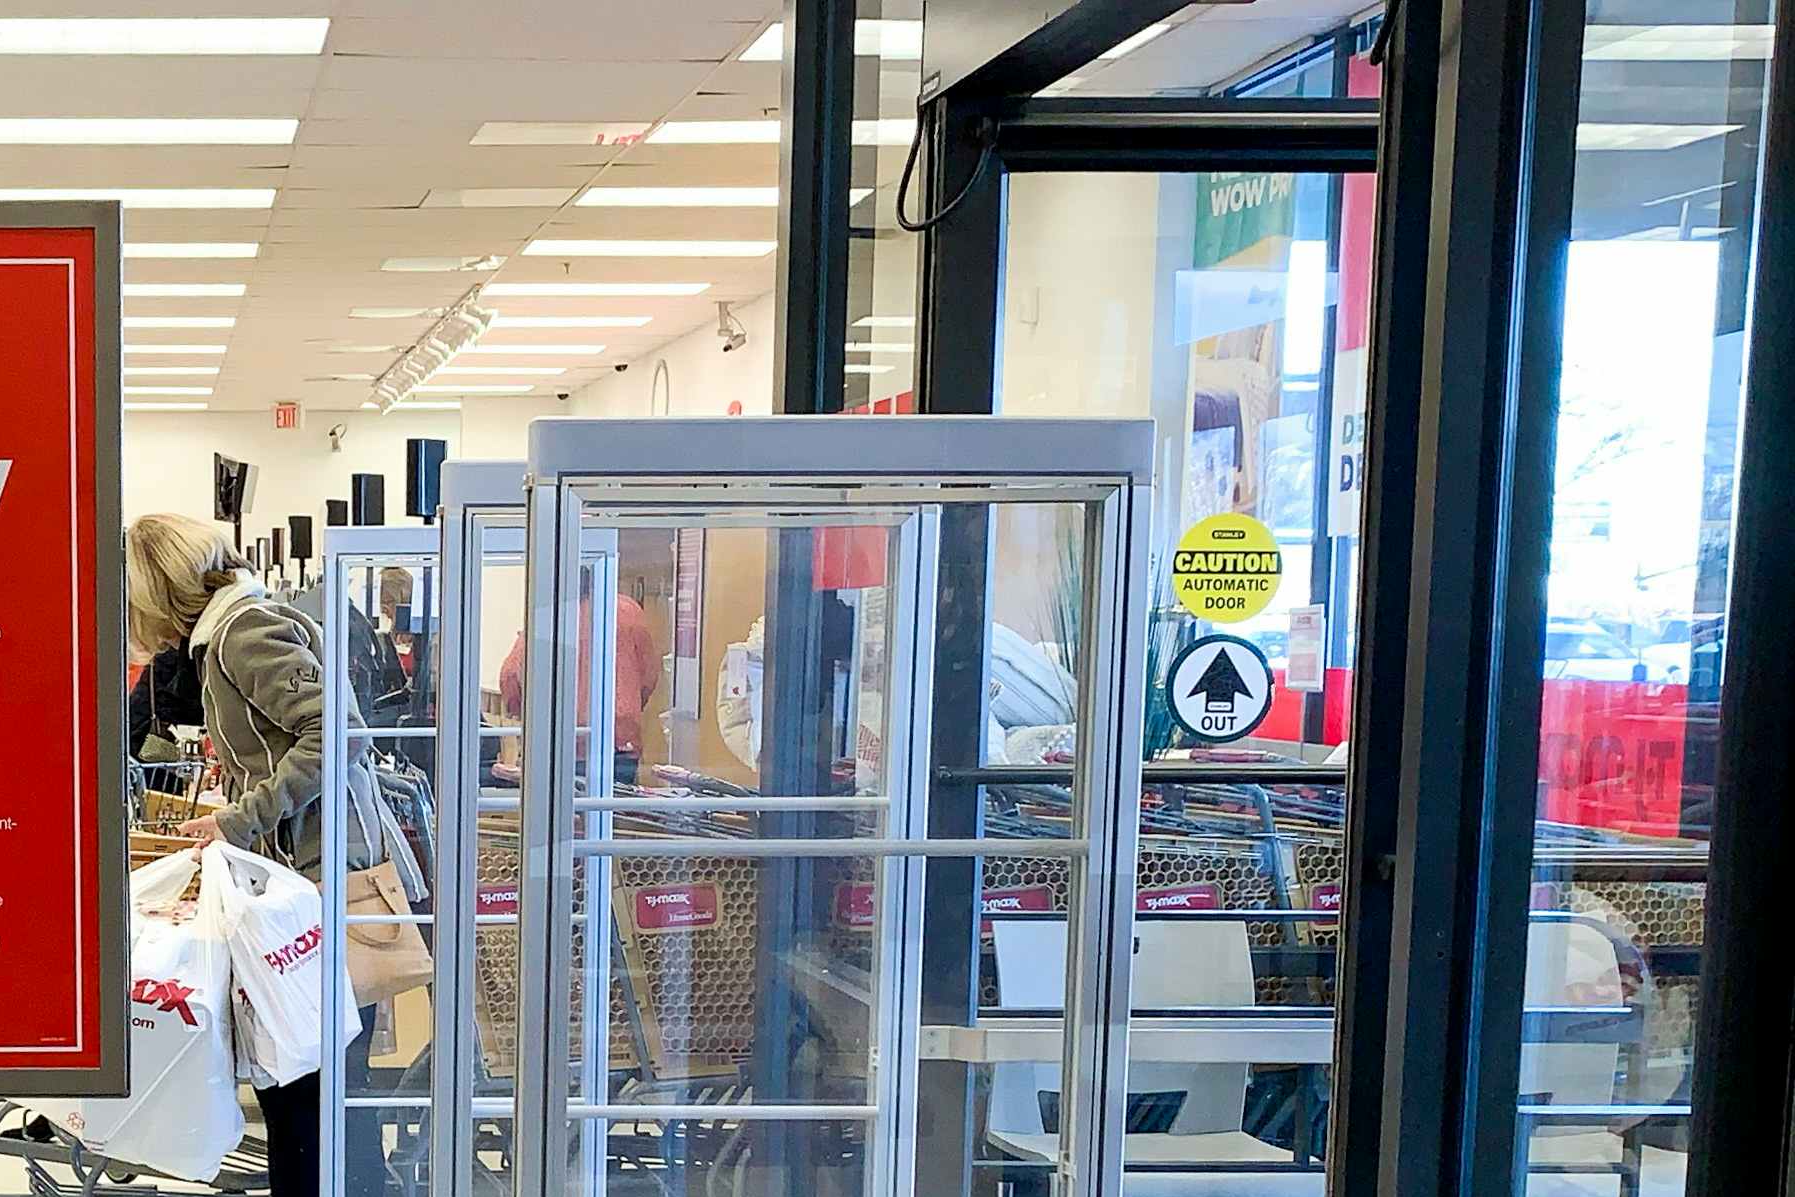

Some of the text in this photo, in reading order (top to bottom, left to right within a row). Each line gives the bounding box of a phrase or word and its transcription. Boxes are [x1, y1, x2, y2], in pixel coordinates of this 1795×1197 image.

[1210, 175, 1267, 217] WOW
[276, 408, 296, 428] EXIT
[1175, 552, 1277, 572] CAUTION
[1183, 579, 1269, 591] AUTOMATIC
[1205, 597, 1246, 609] DOOR
[1201, 716, 1238, 731] OUT
